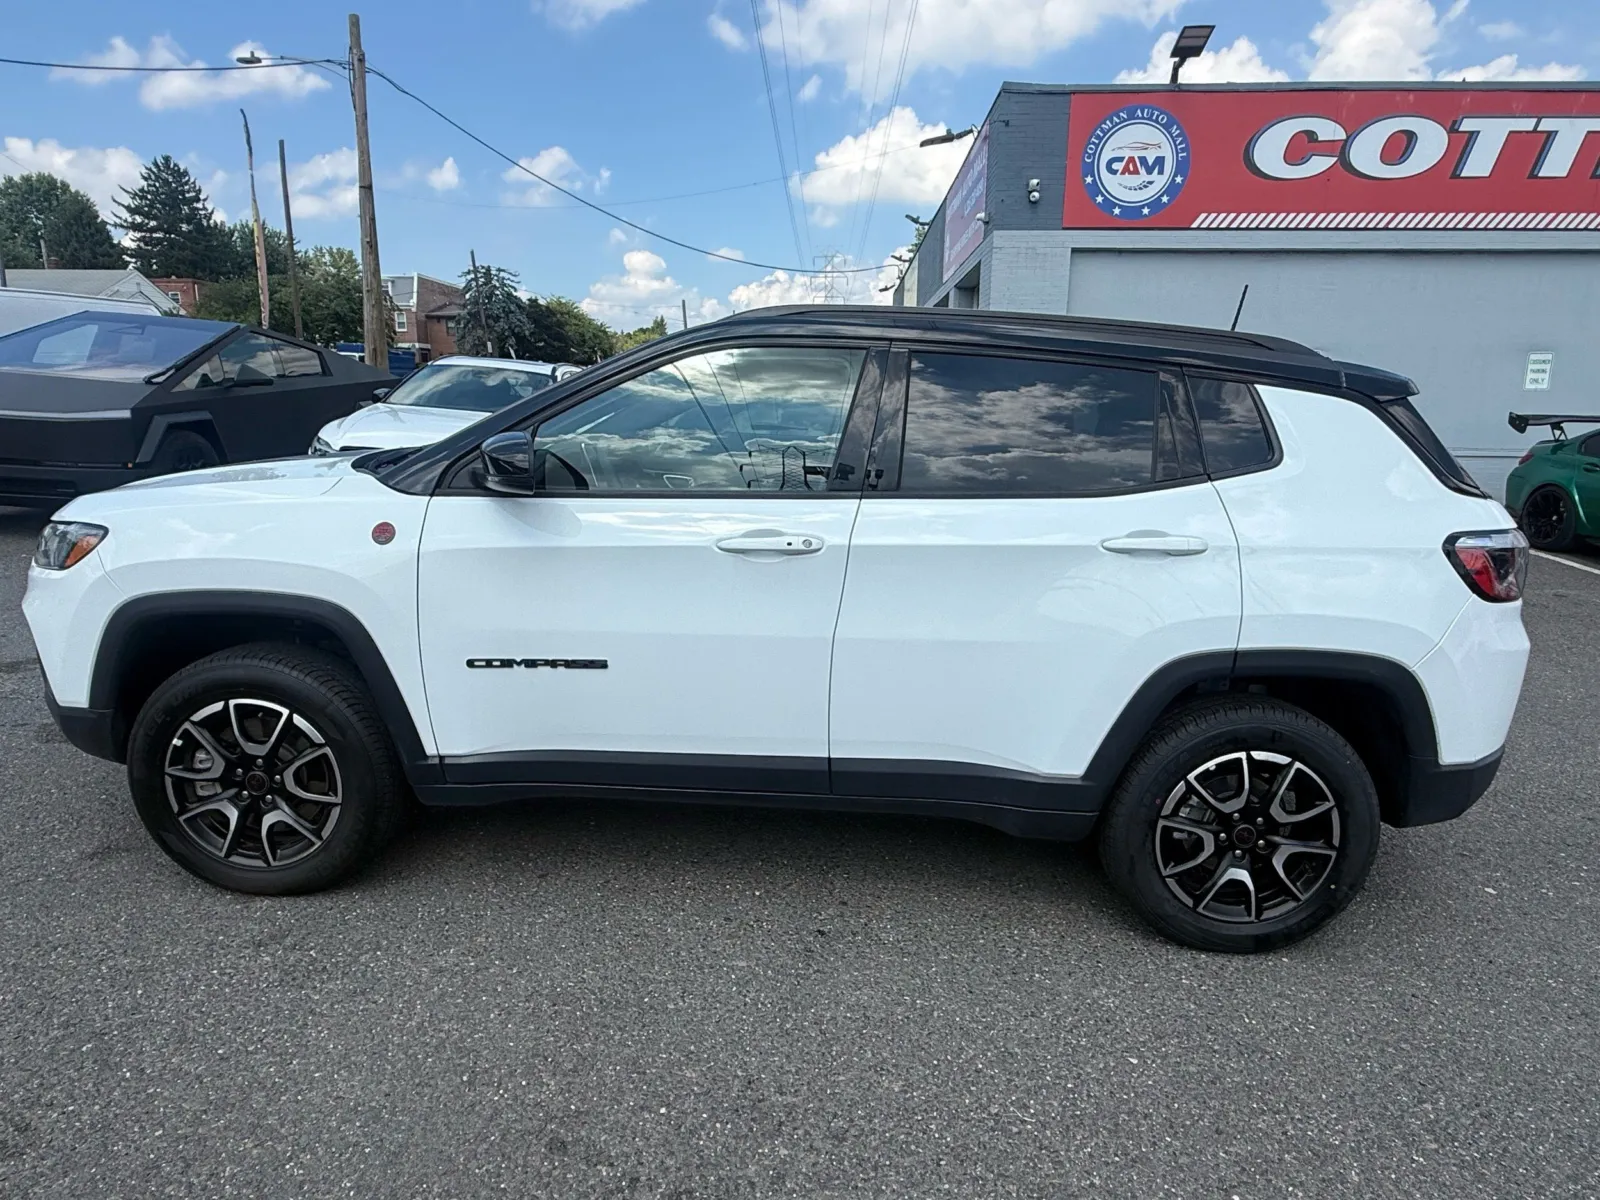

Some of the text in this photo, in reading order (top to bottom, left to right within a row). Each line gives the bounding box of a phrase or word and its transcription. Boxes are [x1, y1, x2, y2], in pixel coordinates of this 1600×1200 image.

[1084, 108, 1187, 163] COTTMAN AUTO MALL
[1246, 116, 1600, 179] COTT
[1105, 155, 1166, 176] CAM
[1529, 377, 1546, 385] ONLY
[466, 658, 609, 669] COMPASS
